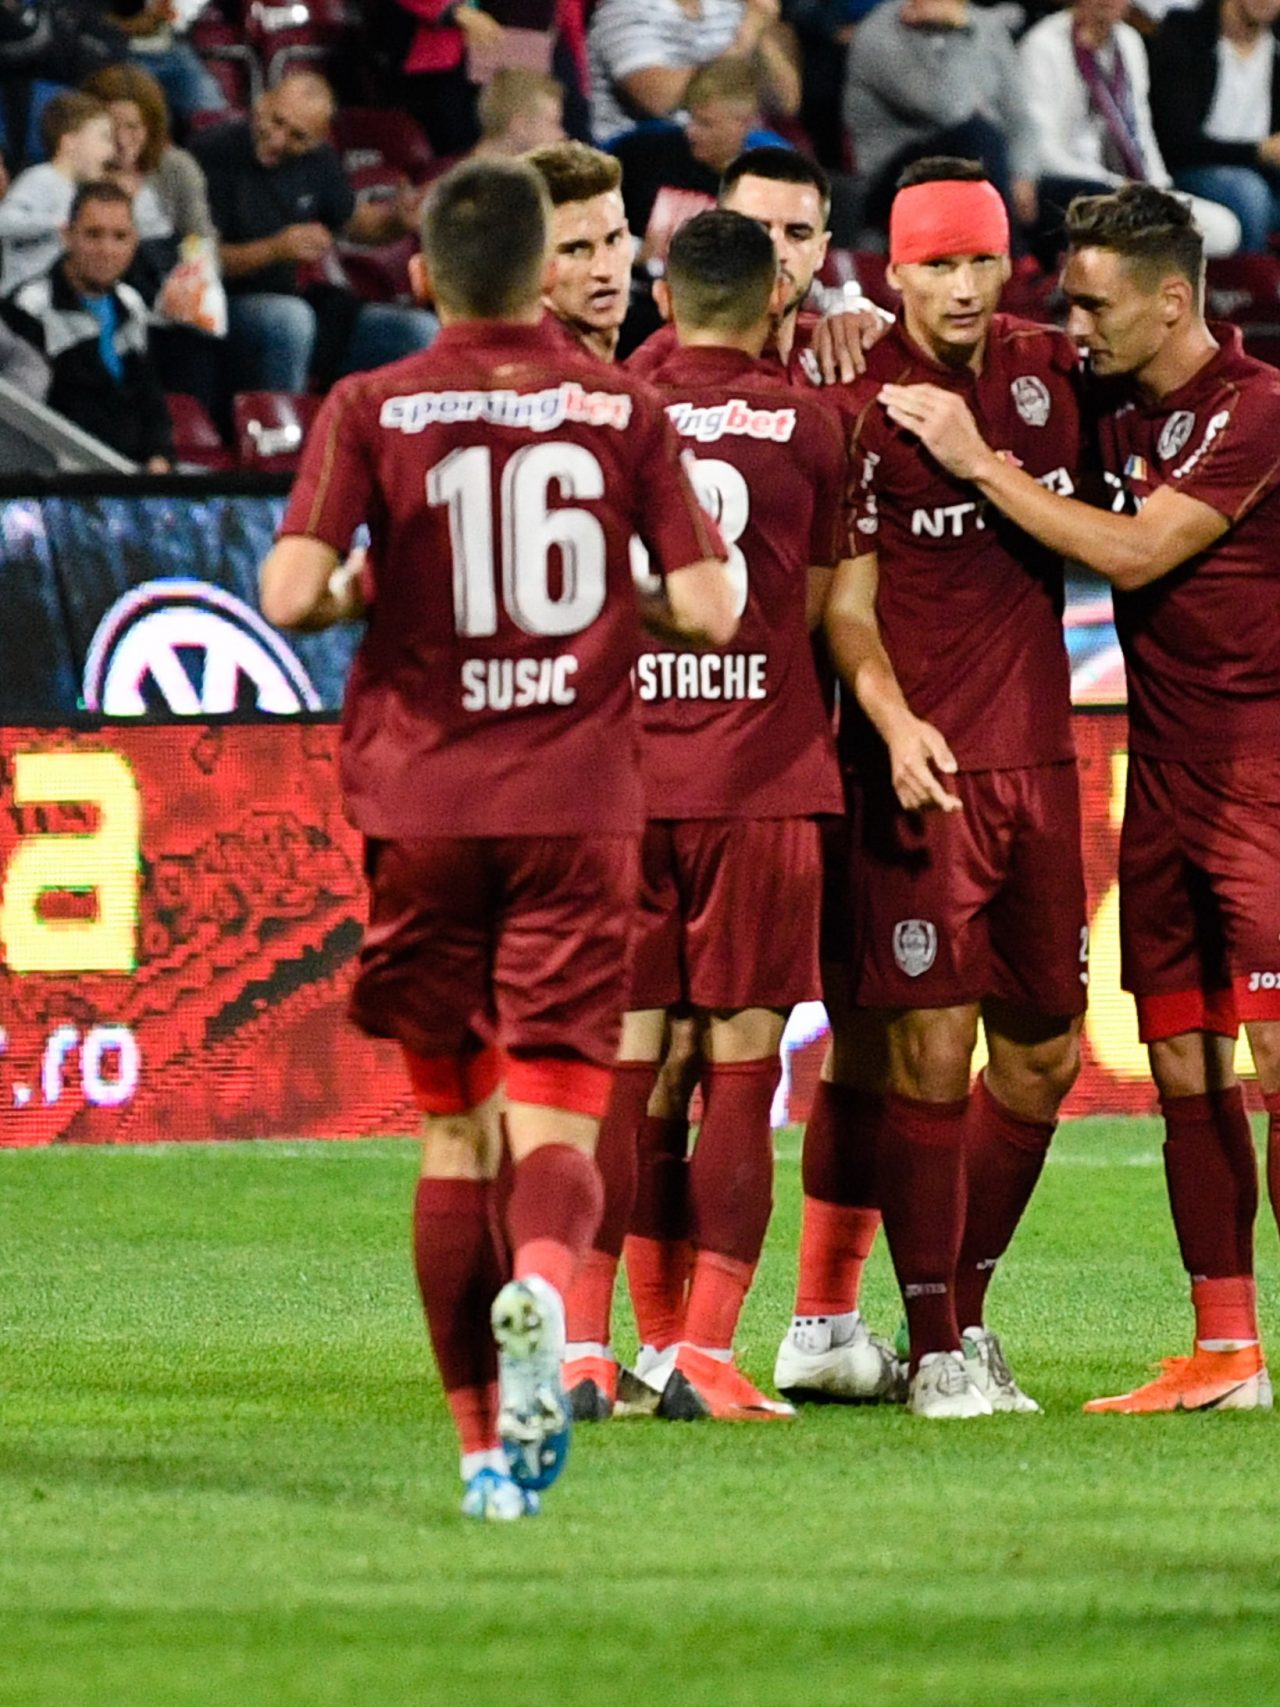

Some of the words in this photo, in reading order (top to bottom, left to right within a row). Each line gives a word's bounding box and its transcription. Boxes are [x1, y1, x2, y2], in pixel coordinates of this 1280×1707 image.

[425, 441, 606, 638] 16
[911, 502, 986, 538] NT
[461, 654, 579, 712] SUSIC
[630, 653, 768, 701] STACHE
[0, 1022, 142, 1107] .ro
